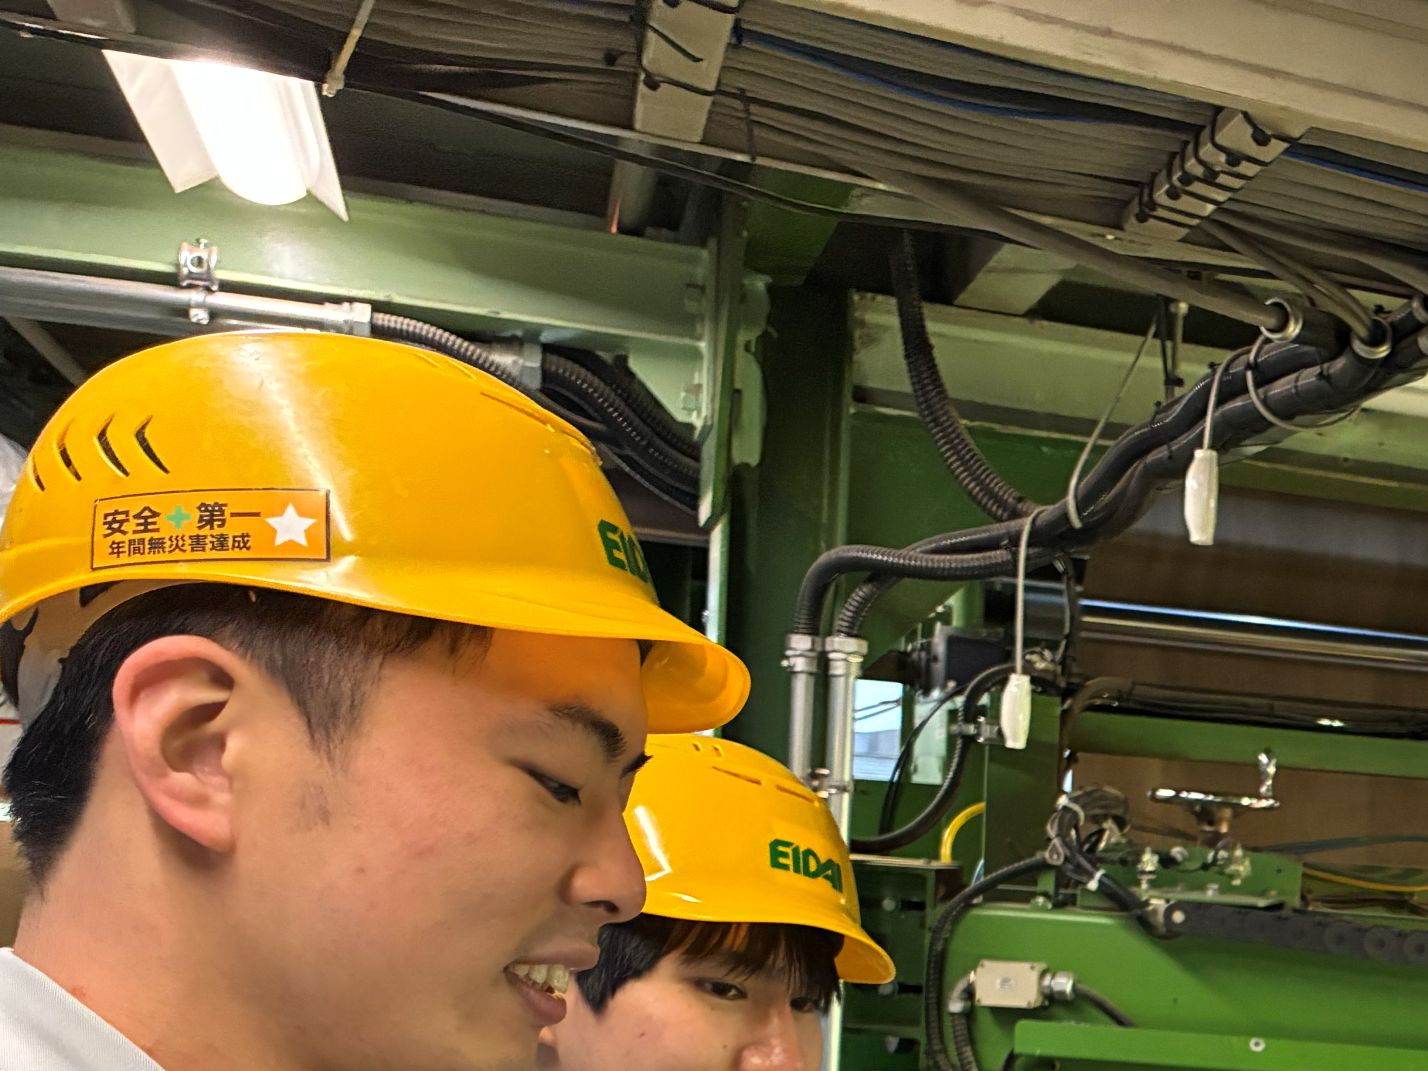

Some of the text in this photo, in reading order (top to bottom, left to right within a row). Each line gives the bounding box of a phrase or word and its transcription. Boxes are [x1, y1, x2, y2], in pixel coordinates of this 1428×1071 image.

[102, 502, 262, 538] 安全 第一
[108, 532, 252, 559] 年間無災害達成
[598, 519, 651, 583] EID
